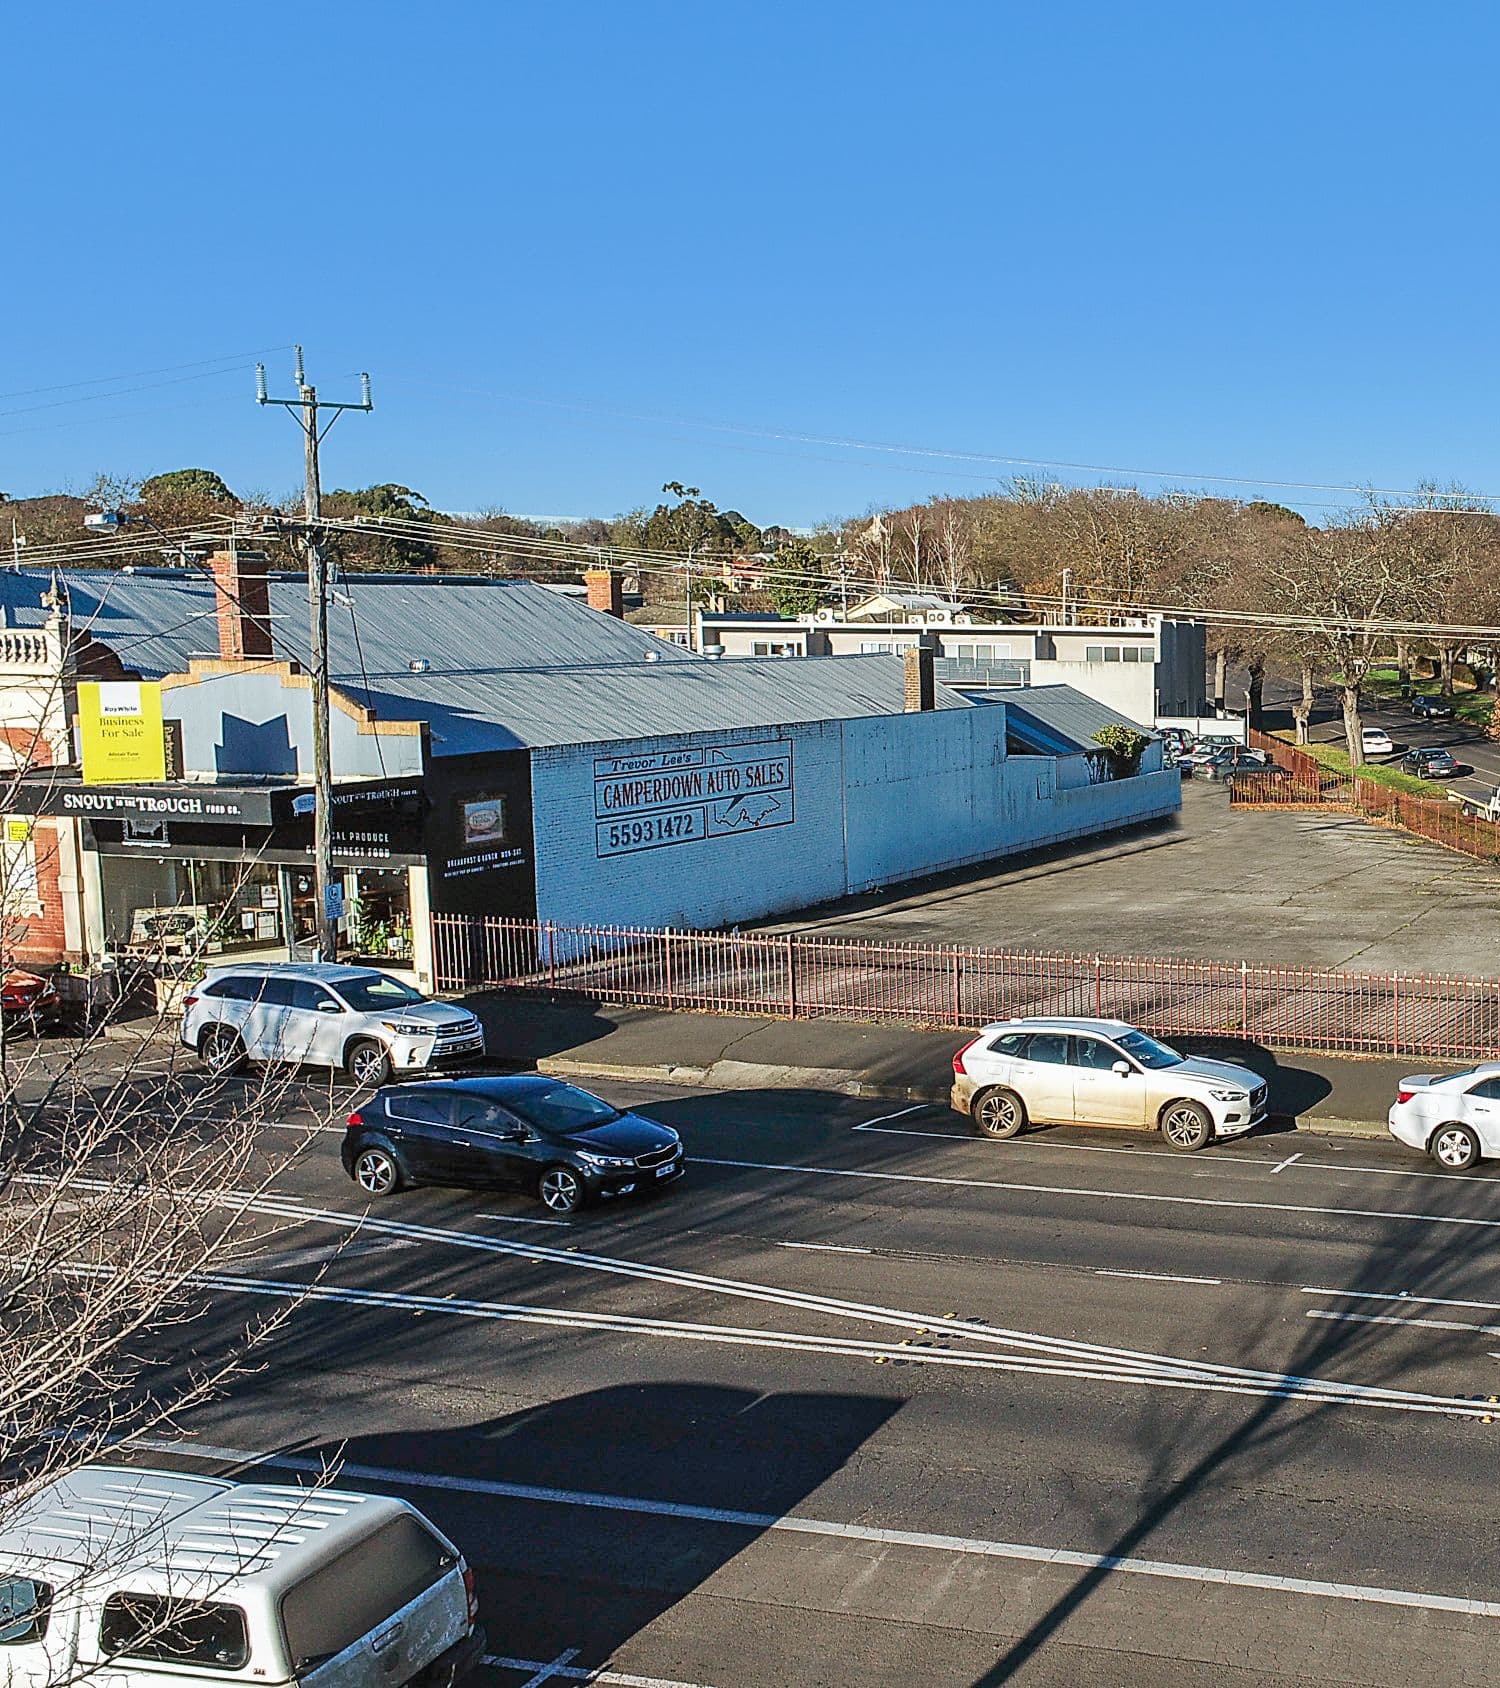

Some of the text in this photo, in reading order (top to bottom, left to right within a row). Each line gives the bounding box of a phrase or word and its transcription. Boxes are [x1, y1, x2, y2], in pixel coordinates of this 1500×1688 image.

[100, 717, 144, 726] Business
[102, 728, 144, 738] For Sale
[611, 752, 691, 772] Trevor Lee's
[603, 762, 784, 809] CAMPERDOWN AUTO SALES
[366, 788, 399, 801] TROUGH
[63, 793, 114, 810] SNOUT
[136, 796, 202, 814] TROUGH
[349, 832, 390, 843] PRODUCE
